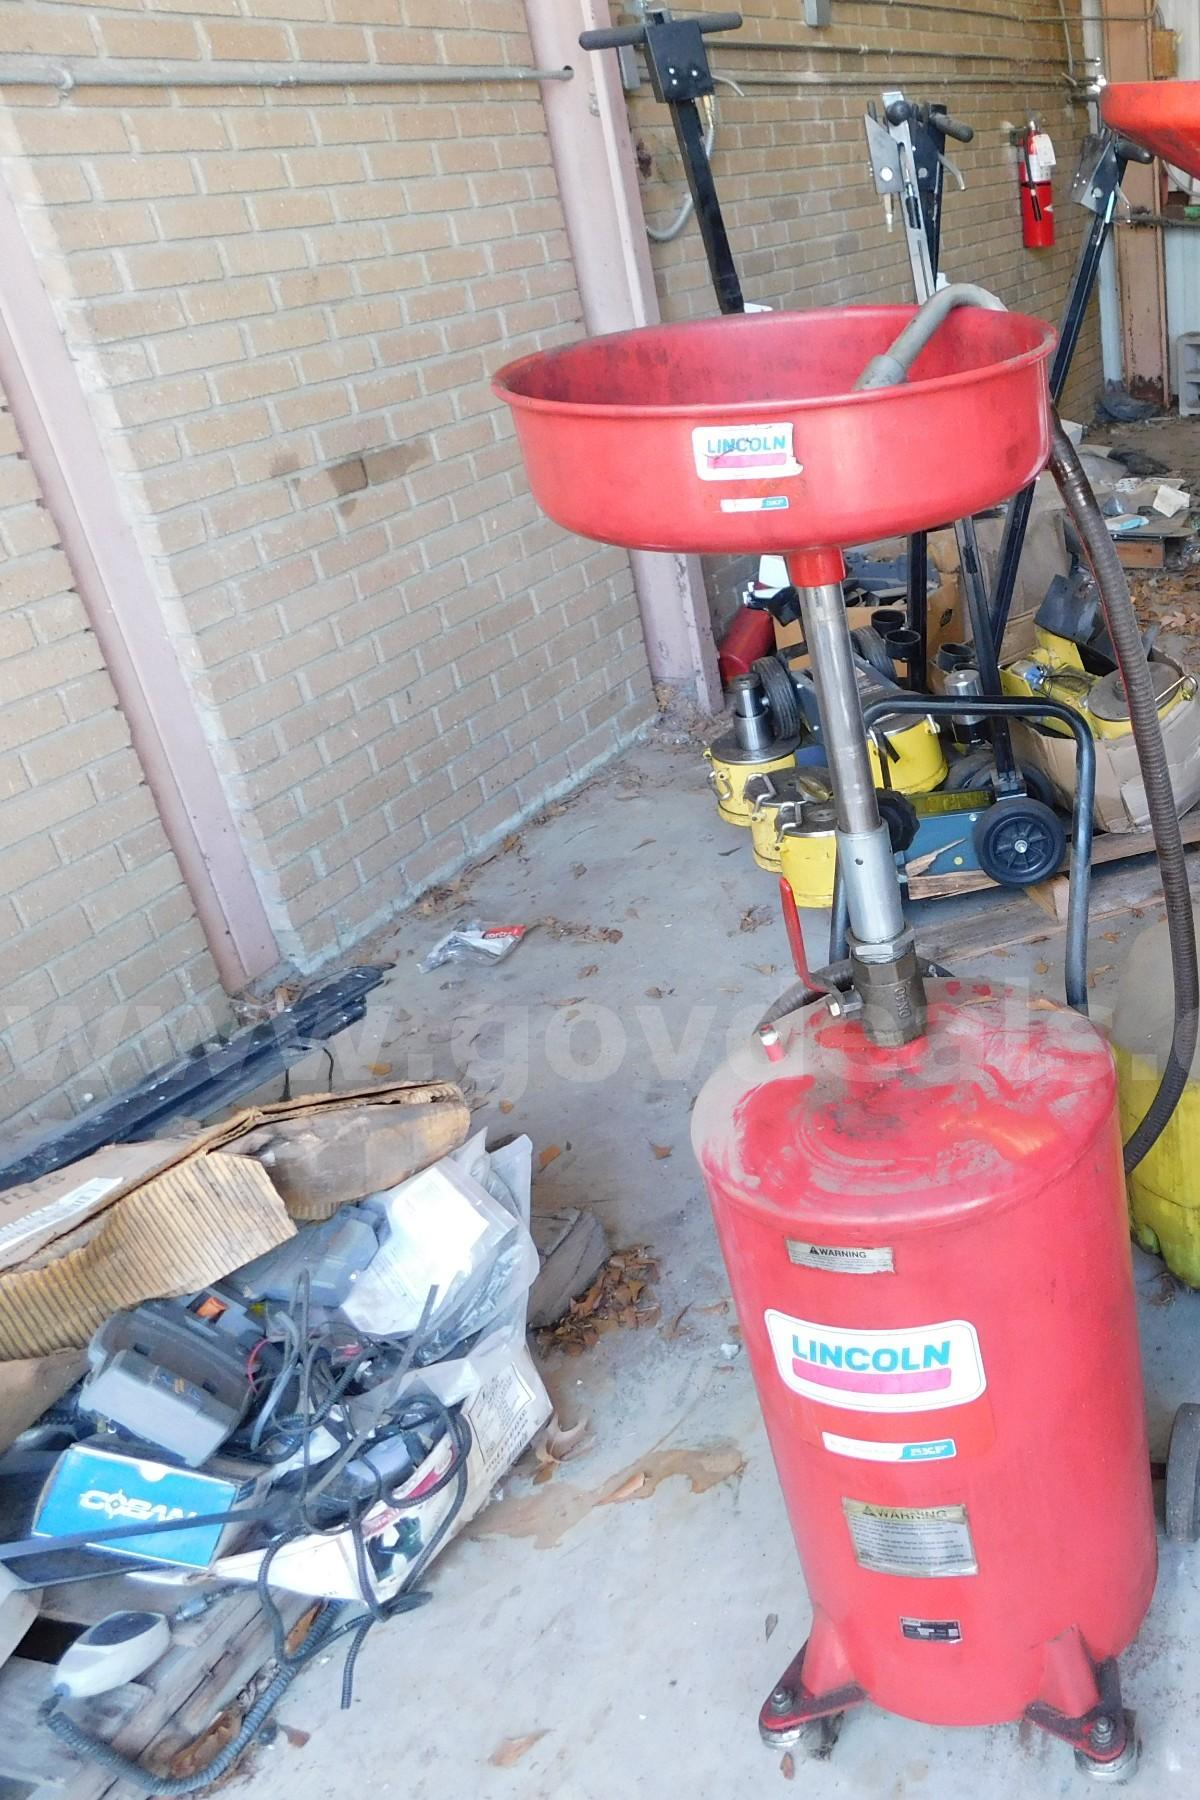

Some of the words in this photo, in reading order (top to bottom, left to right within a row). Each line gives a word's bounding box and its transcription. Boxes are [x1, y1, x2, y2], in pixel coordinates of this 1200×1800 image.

[707, 436, 786, 454] LINCOLN
[818, 1246, 867, 1259] WARNING
[792, 1333, 951, 1373] LINCOLN
